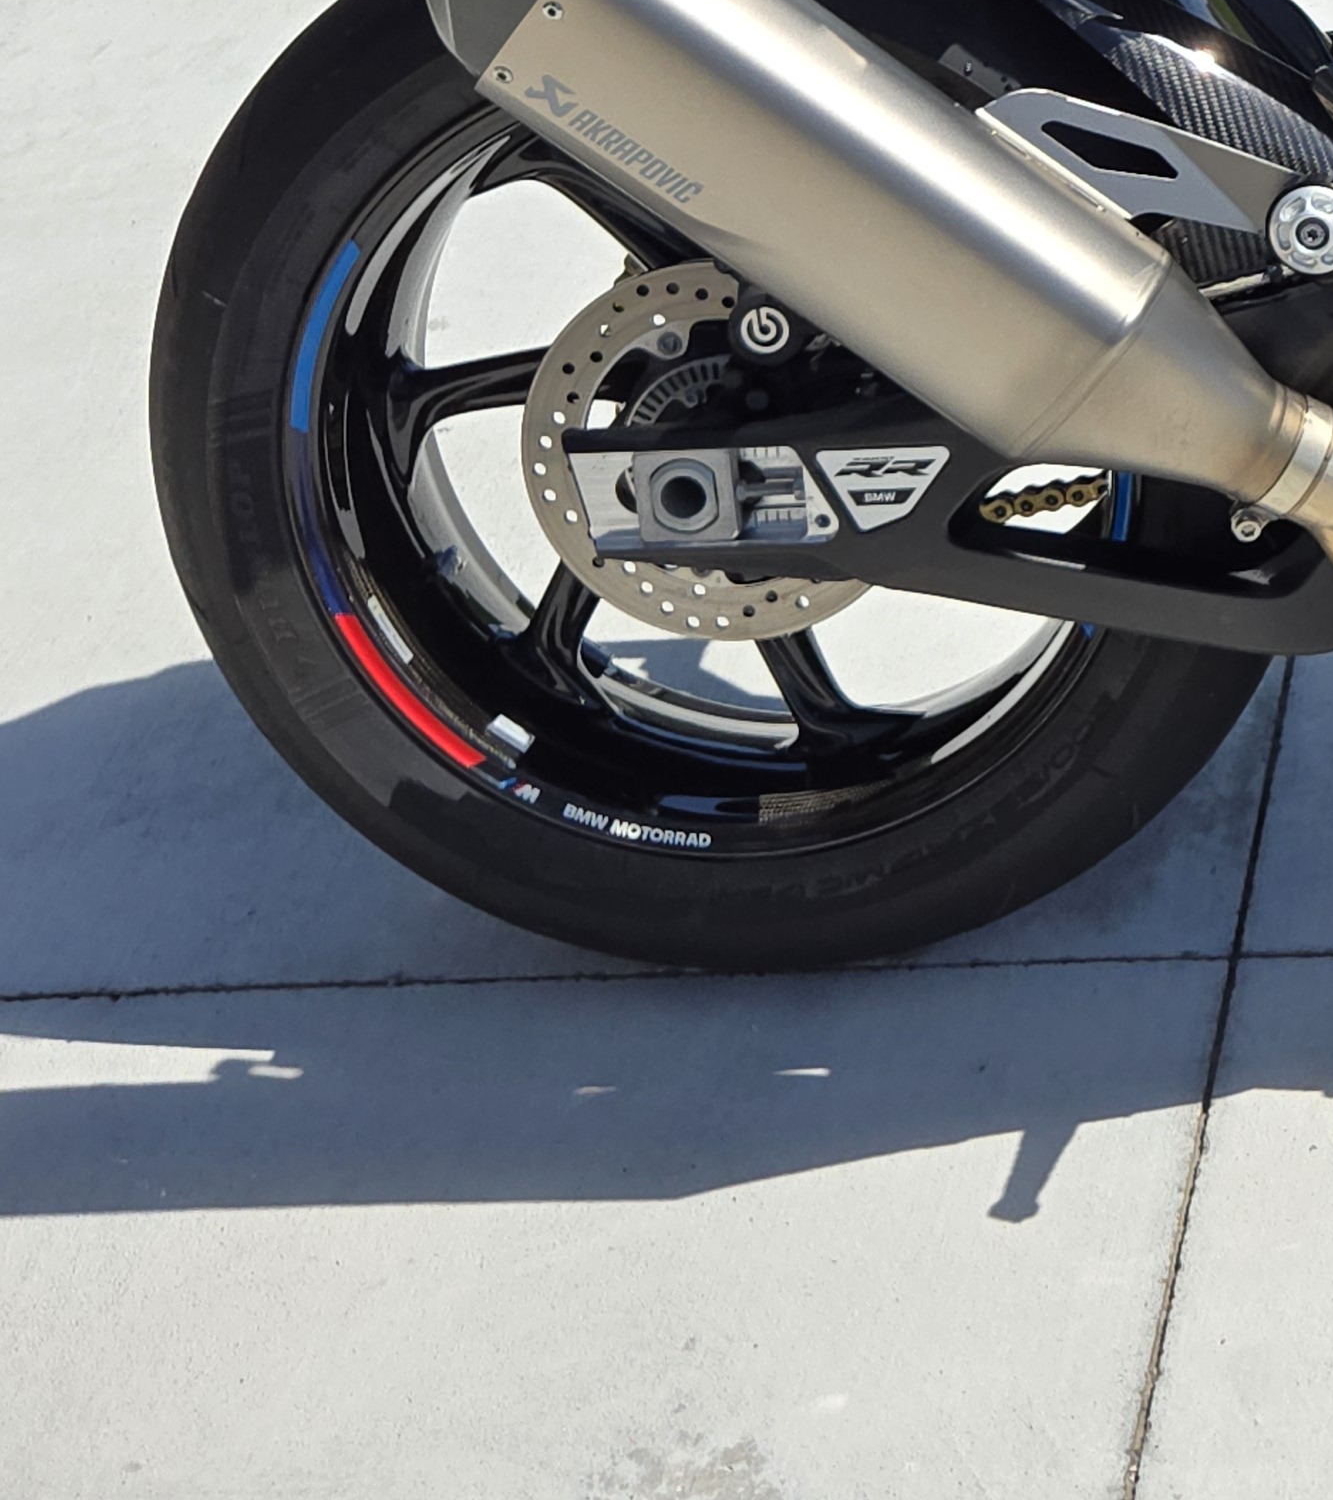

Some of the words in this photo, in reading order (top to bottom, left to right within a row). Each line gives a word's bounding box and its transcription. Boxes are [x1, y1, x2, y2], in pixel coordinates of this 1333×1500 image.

[863, 492, 896, 503] BMW
[563, 803, 609, 831] BMW
[610, 819, 712, 848] MOTORRAD
